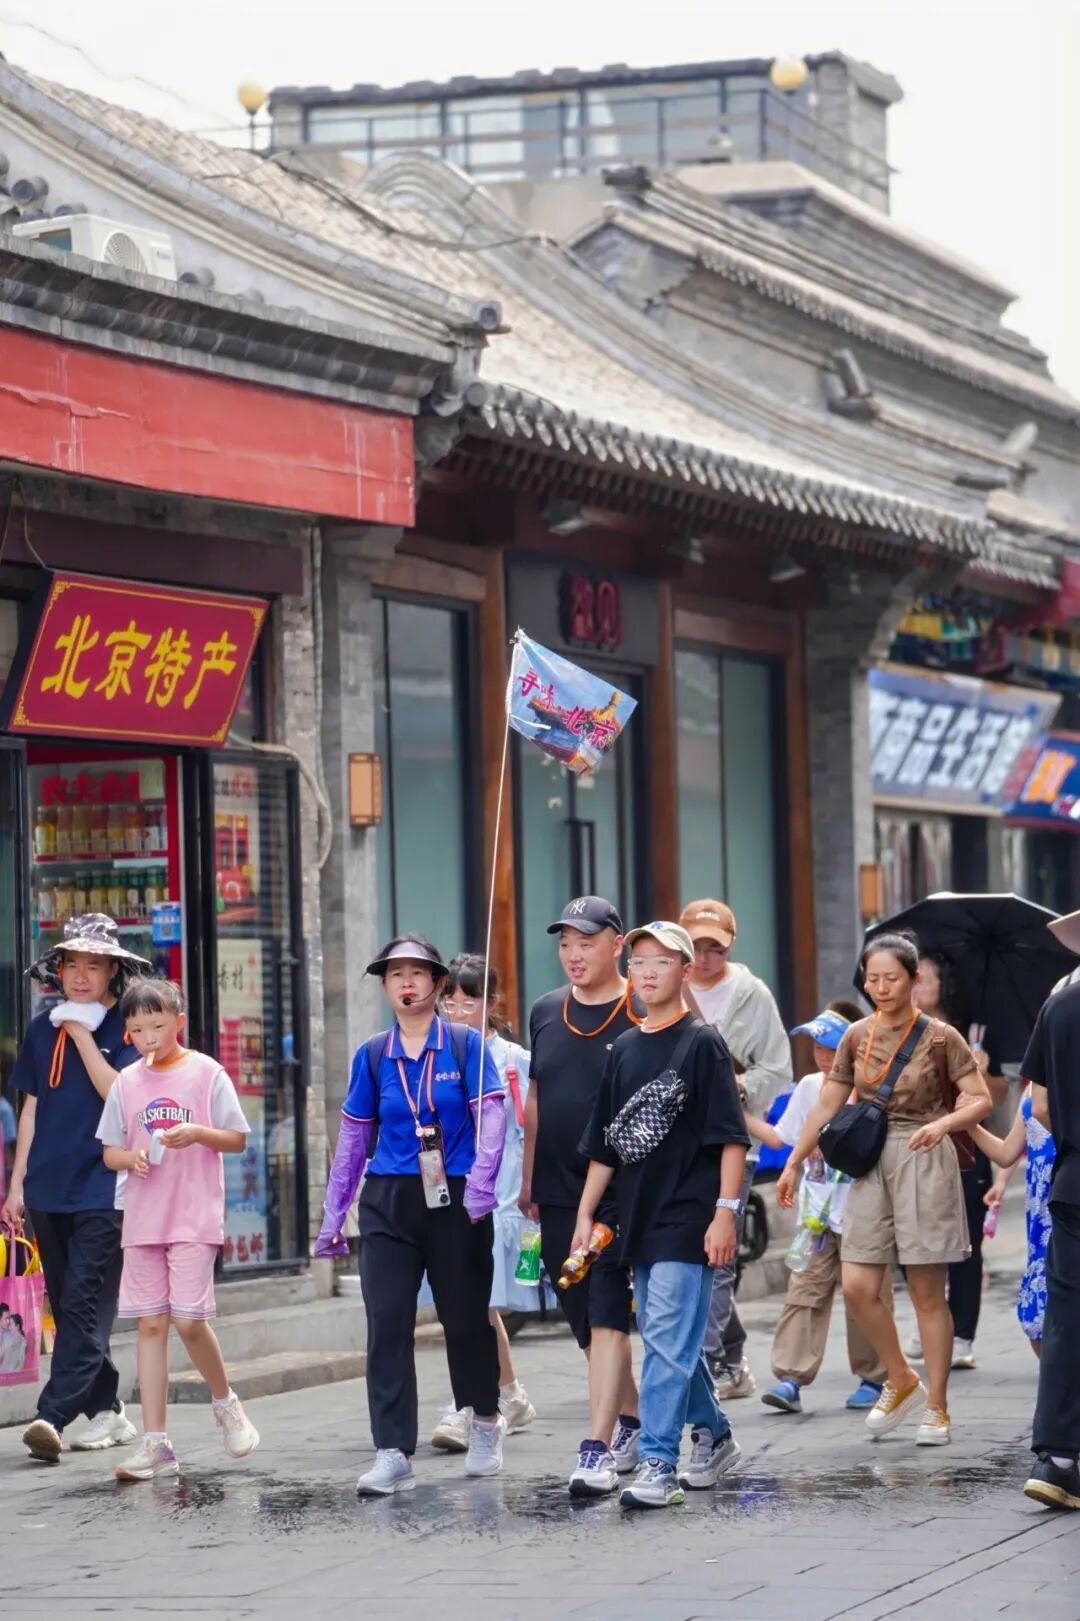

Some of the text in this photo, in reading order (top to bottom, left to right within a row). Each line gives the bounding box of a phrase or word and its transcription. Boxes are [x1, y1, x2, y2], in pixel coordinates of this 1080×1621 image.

[40, 613, 239, 710] 北京特产
[569, 900, 587, 915] NY
[137, 1106, 194, 1128] BASKETBALL
